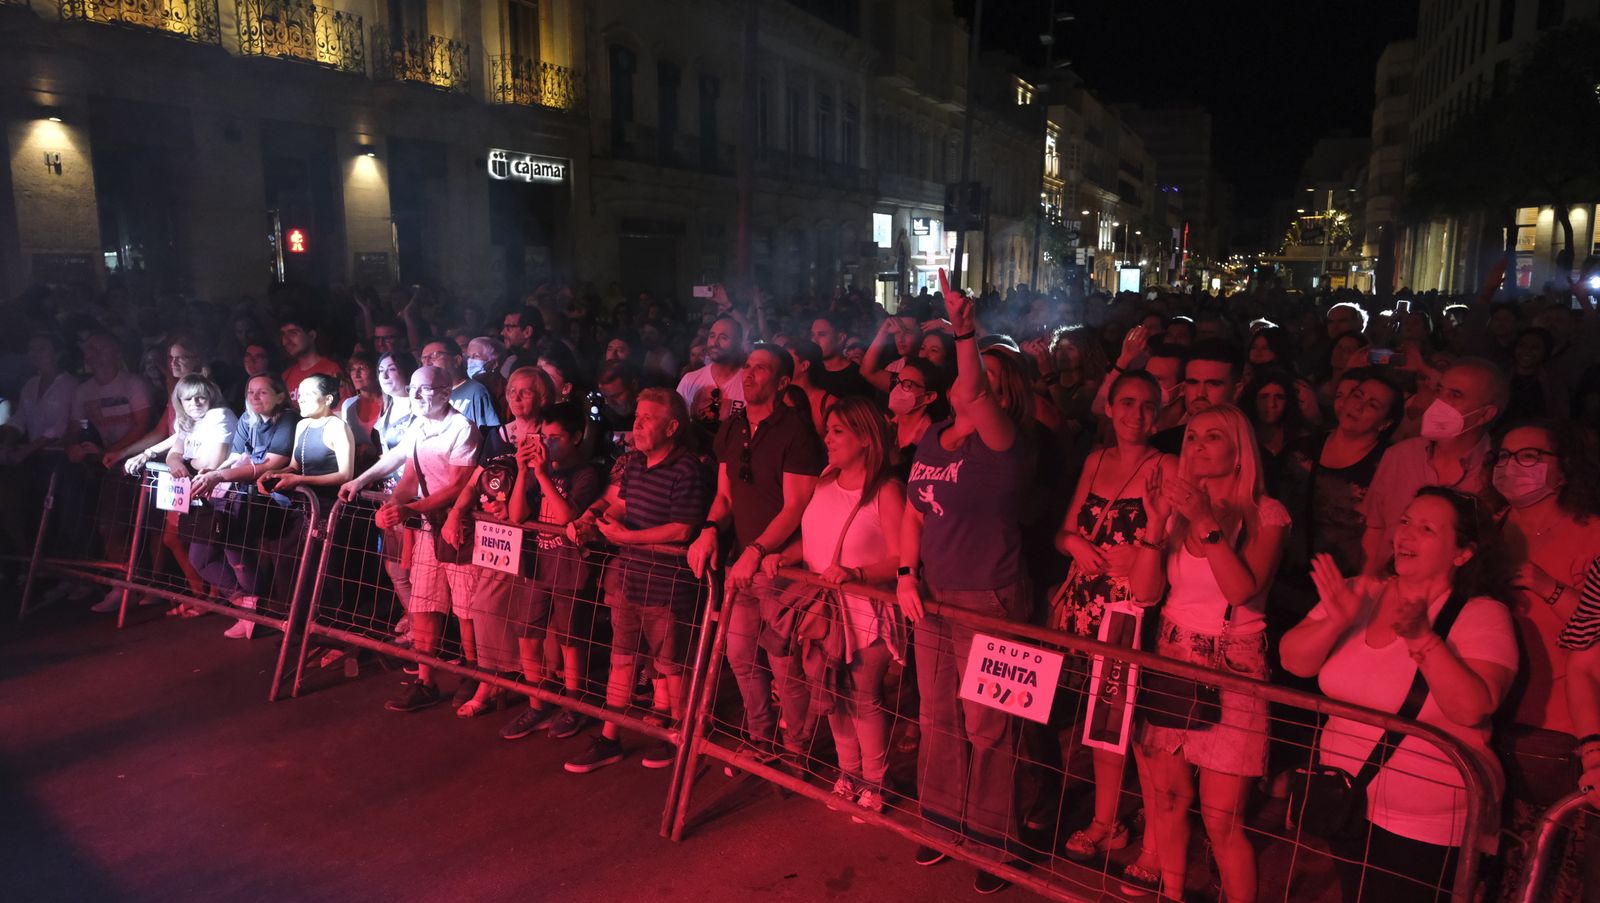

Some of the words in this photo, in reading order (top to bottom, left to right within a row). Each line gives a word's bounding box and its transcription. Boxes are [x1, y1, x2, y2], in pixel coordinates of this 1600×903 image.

[514, 157, 567, 180] cajamar
[483, 525, 513, 537] GRUPO
[481, 536, 511, 552] RENTA
[987, 642, 1042, 664] GRUPO
[981, 657, 1037, 687] RENTA
